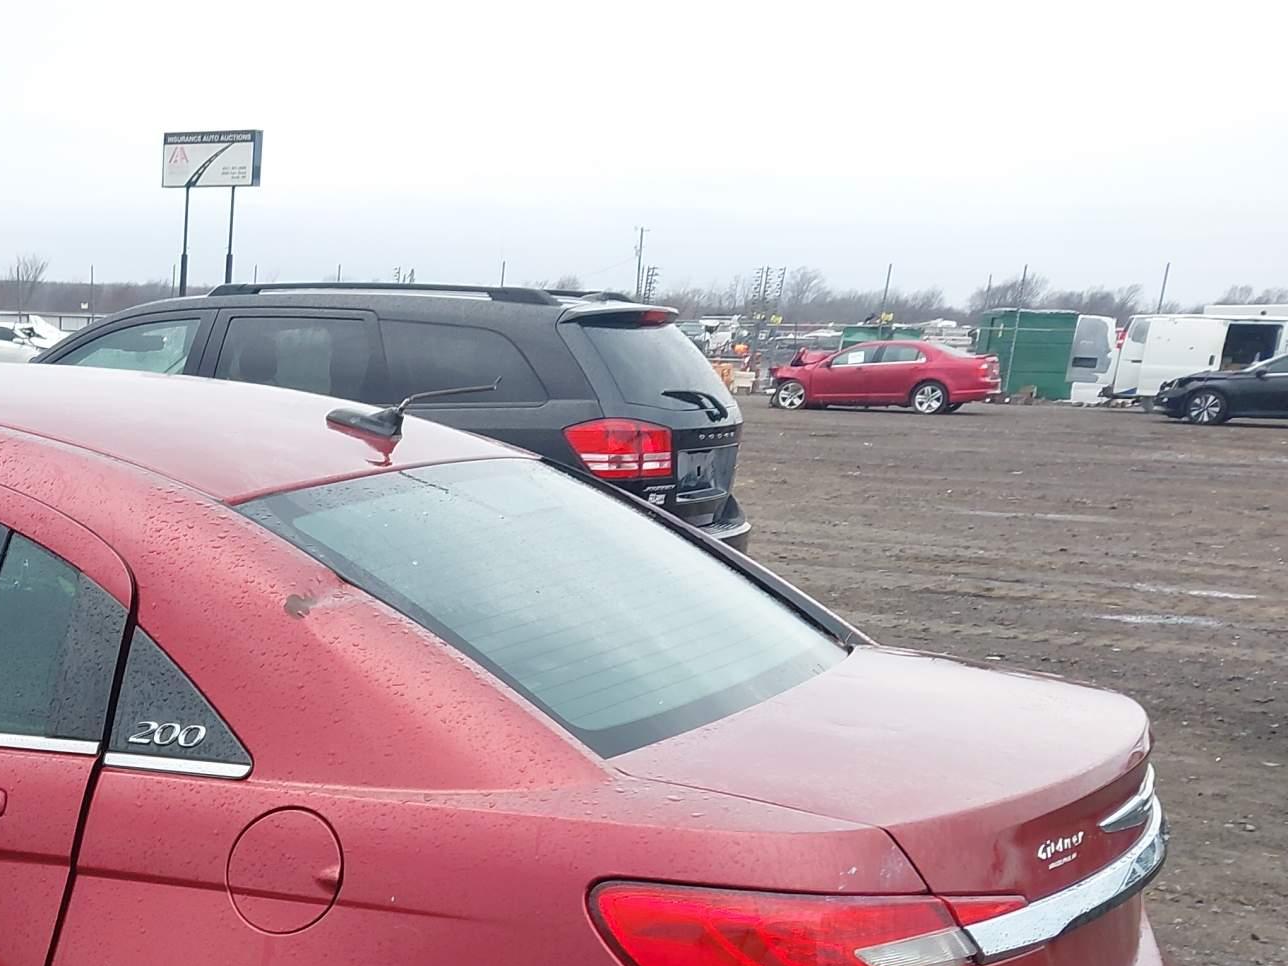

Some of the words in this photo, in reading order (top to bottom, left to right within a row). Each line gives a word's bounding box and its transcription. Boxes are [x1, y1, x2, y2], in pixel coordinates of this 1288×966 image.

[167, 135, 202, 143] INSURANCE
[202, 134, 220, 142] AUTO
[220, 133, 252, 142] AUCTIONS
[128, 721, 207, 748] 200
[1037, 831, 1085, 860] Gildner
